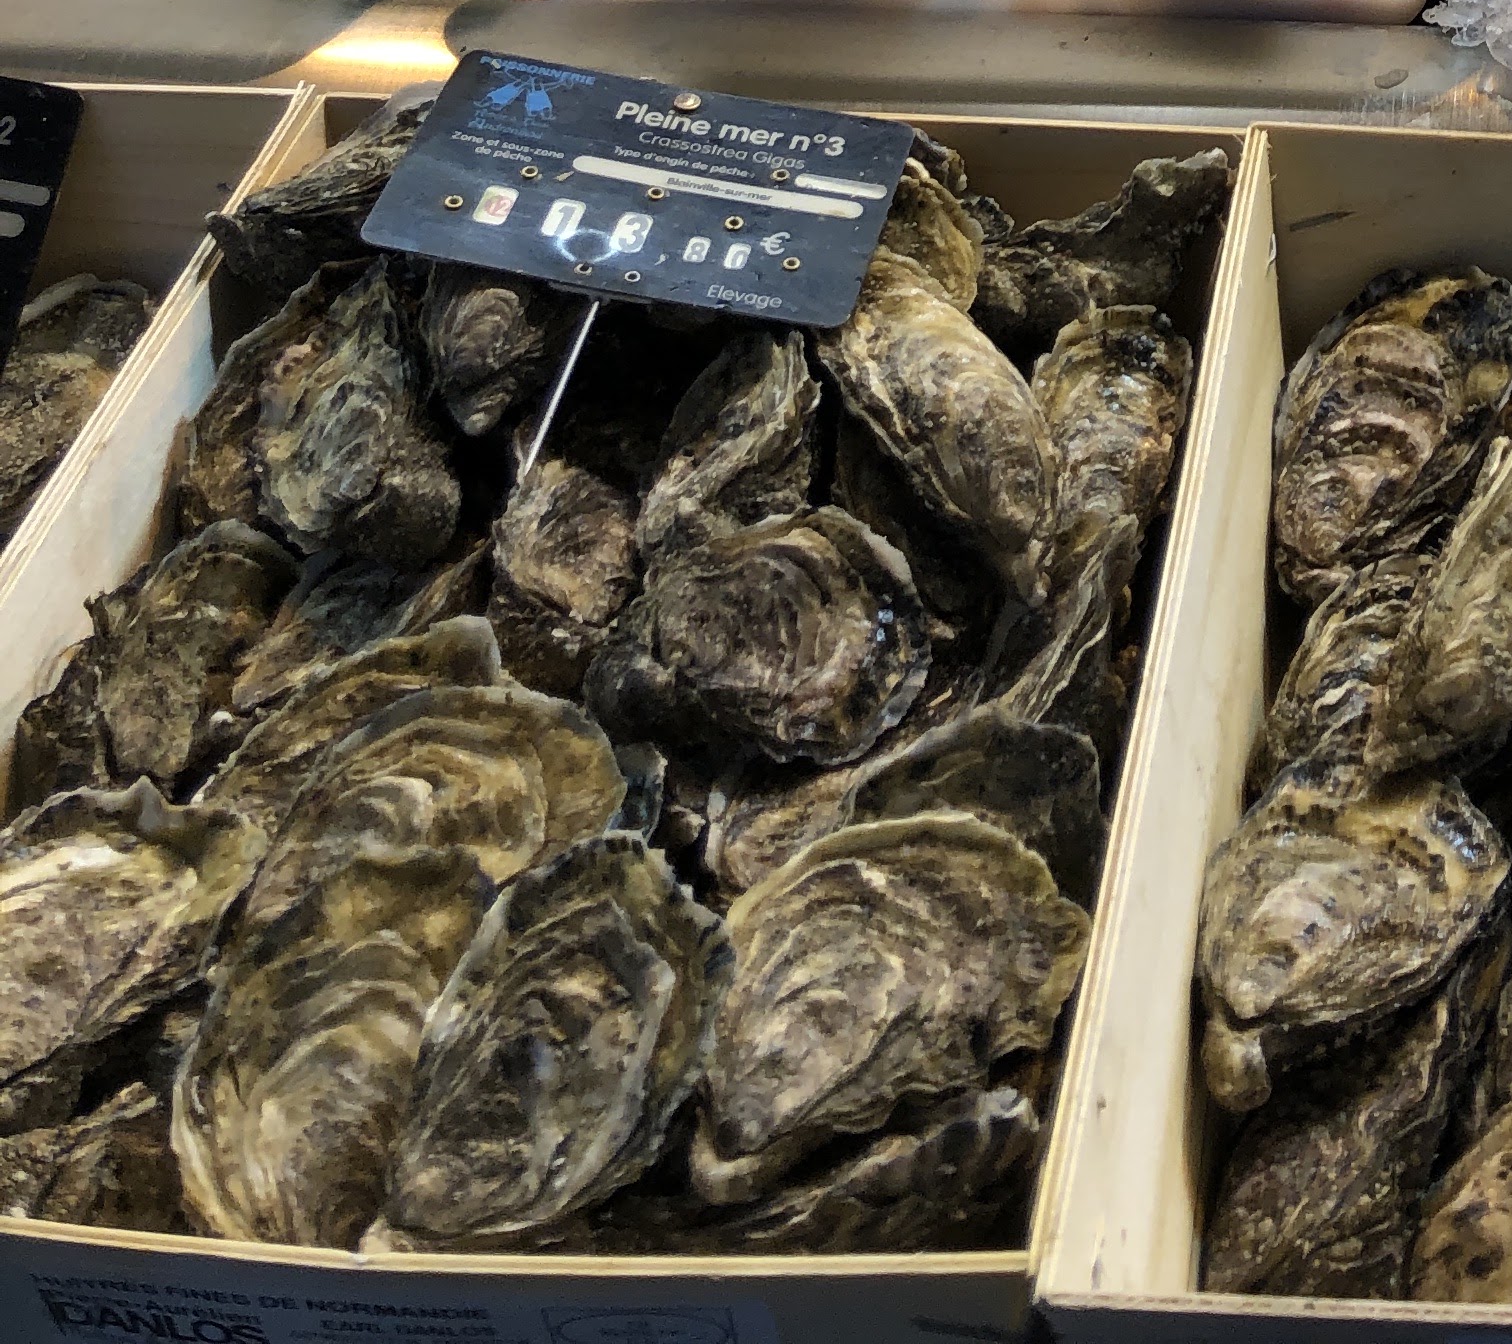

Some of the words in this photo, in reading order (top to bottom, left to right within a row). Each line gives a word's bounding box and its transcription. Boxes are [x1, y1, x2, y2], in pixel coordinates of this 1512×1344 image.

[615, 101, 711, 136] Pleine
[718, 123, 784, 147] mer
[789, 133, 846, 157] n°3
[451, 130, 484, 144] Zone
[486, 138, 500, 147] et
[501, 141, 565, 160] sous-zone
[475, 145, 491, 155] de
[493, 148, 532, 163] pêche
[638, 131, 748, 161] Crassostrea
[752, 151, 805, 170] Gigas
[613, 145, 641, 159] Type
[643, 151, 689, 168] d'engin
[692, 160, 708, 171] de
[710, 164, 750, 179] pêche
[666, 177, 773, 202] Blainville-sur-mer
[707, 284, 783, 310] Elevage
